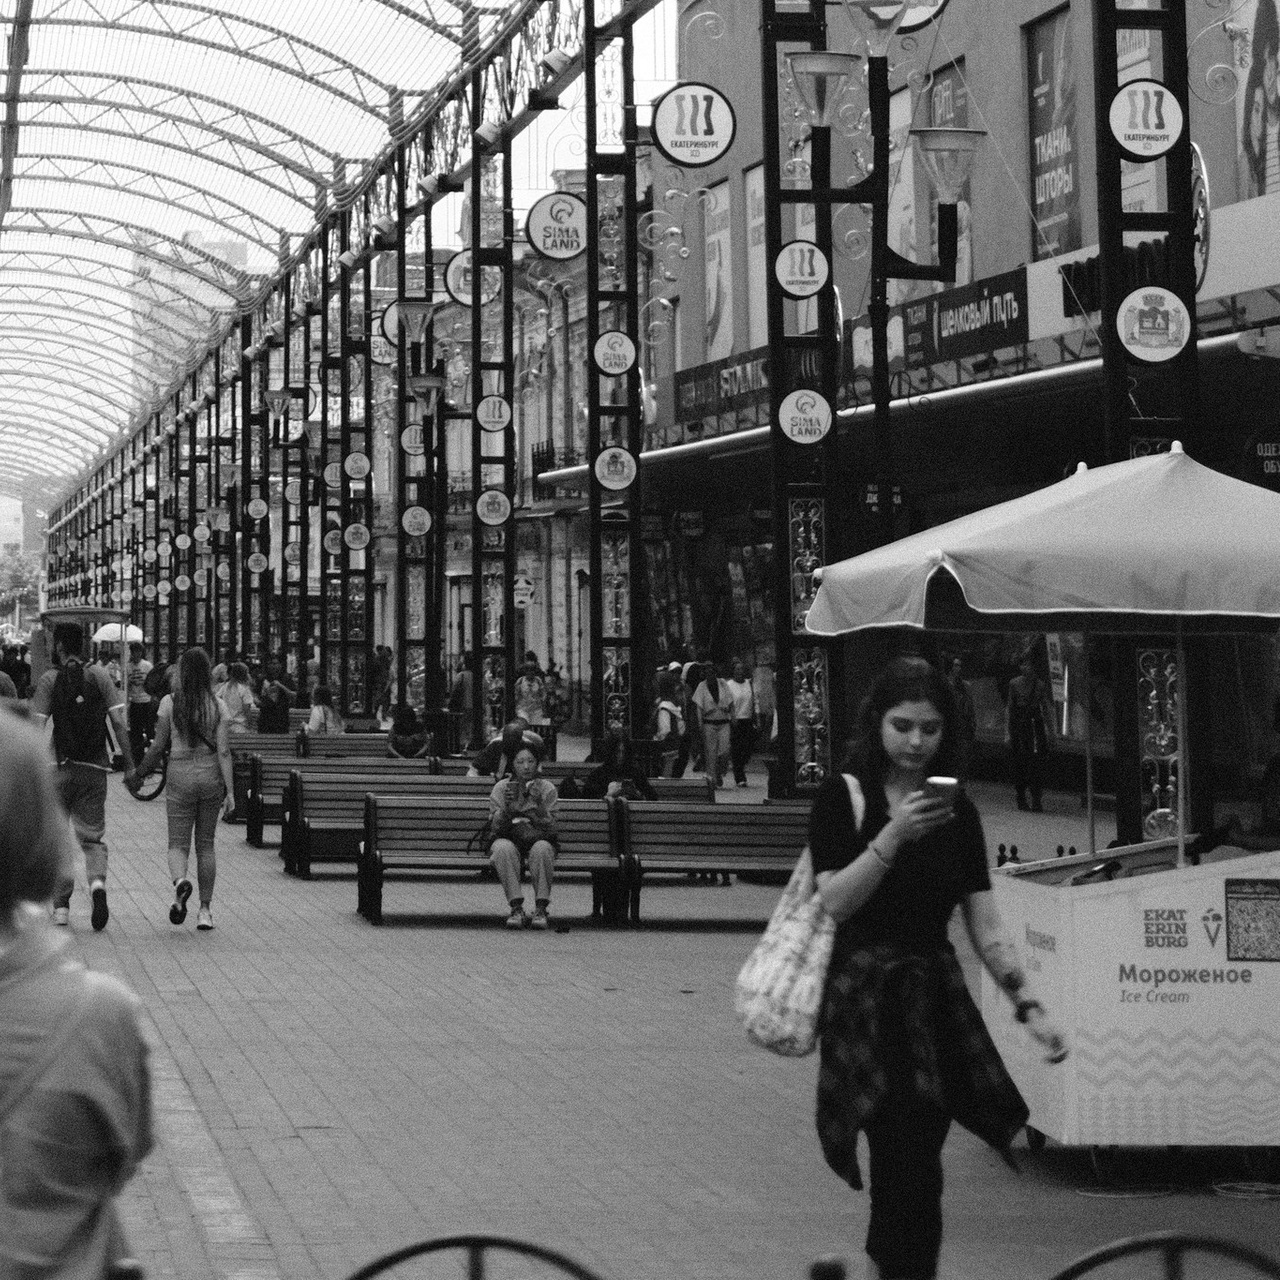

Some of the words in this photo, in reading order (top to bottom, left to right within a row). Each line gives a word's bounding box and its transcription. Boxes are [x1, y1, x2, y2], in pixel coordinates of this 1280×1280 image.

[1124, 133, 1170, 142] ЕКАТЕРИНБУРГ
[670, 140, 719, 149] ЕКАТЕРИНБУРГ
[1035, 162, 1072, 205] ШТОРЫ
[542, 226, 580, 239] SIMA
[542, 239, 580, 251] LAND
[790, 416, 821, 427] SIMA
[790, 427, 822, 438] LAND
[1257, 443, 1280, 457] ОДЕ
[1143, 909, 1188, 921] EKAT
[1143, 922, 1187, 934] ERIN
[1144, 936, 1189, 948] BURG
[1119, 963, 1253, 988] Мороженое
[1120, 990, 1142, 1003] Ice
[1146, 990, 1190, 1003] Cream
